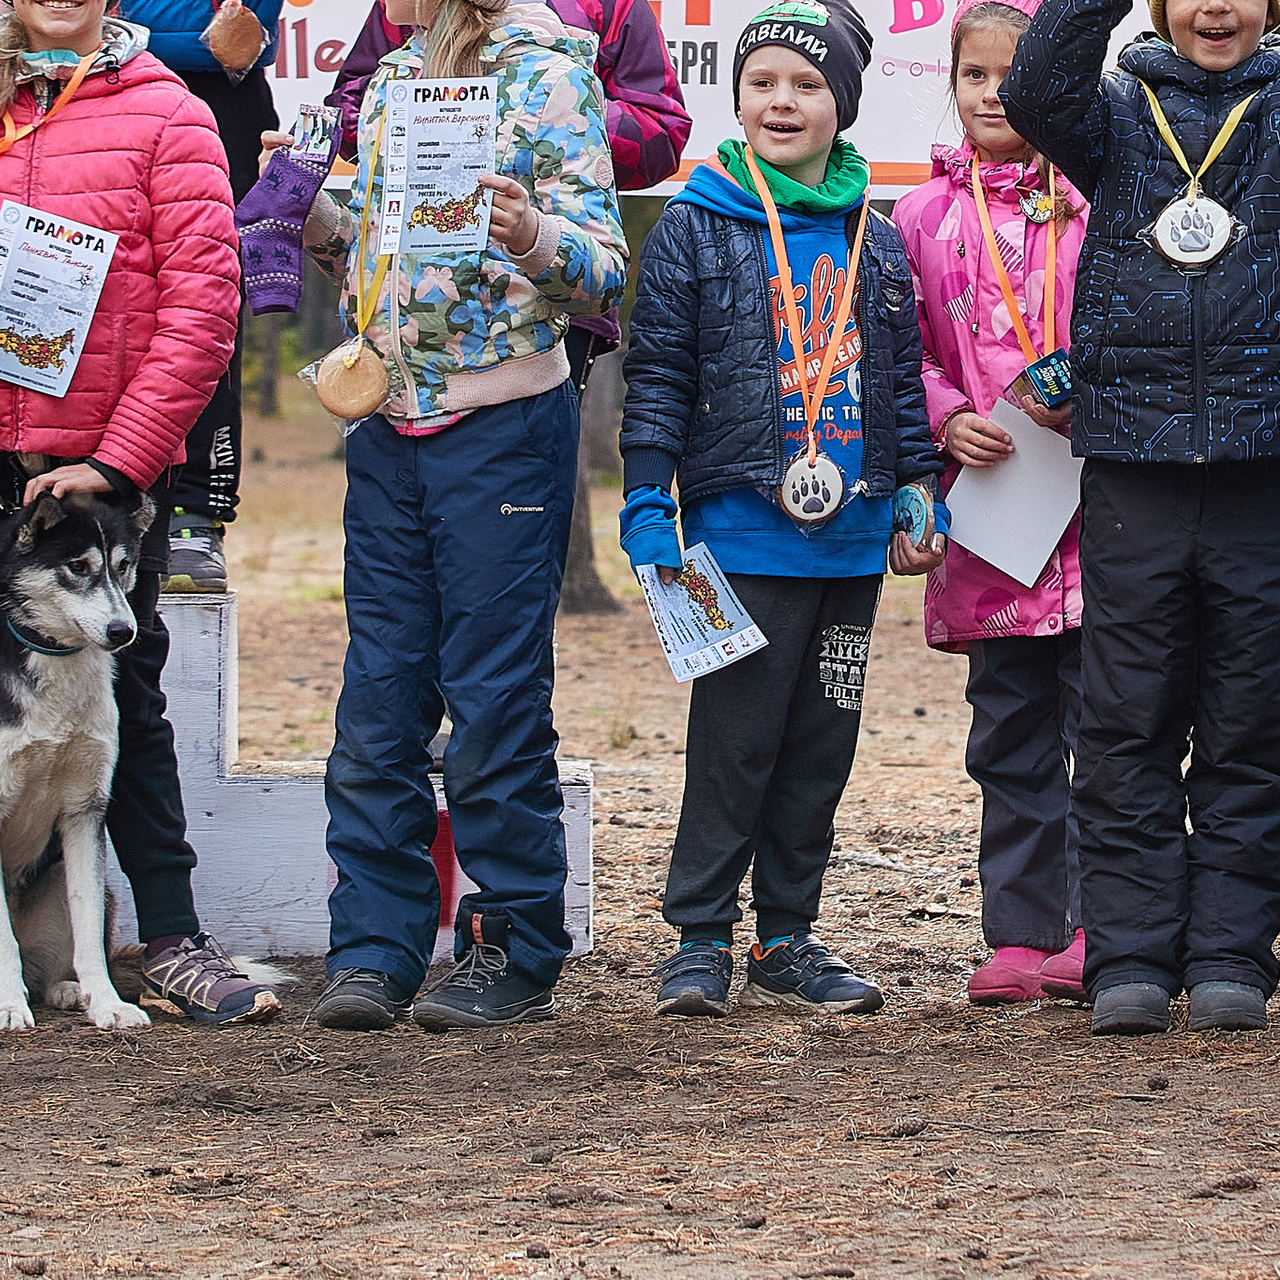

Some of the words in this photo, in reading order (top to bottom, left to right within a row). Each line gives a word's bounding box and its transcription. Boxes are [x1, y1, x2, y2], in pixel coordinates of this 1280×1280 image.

[739, 23, 829, 63] САВЕЛИЙ
[414, 85, 490, 103] ГРАМОТА
[25, 216, 105, 254] ГРАМОТА
[827, 642, 861, 659] NYC
[819, 661, 866, 685] STA
